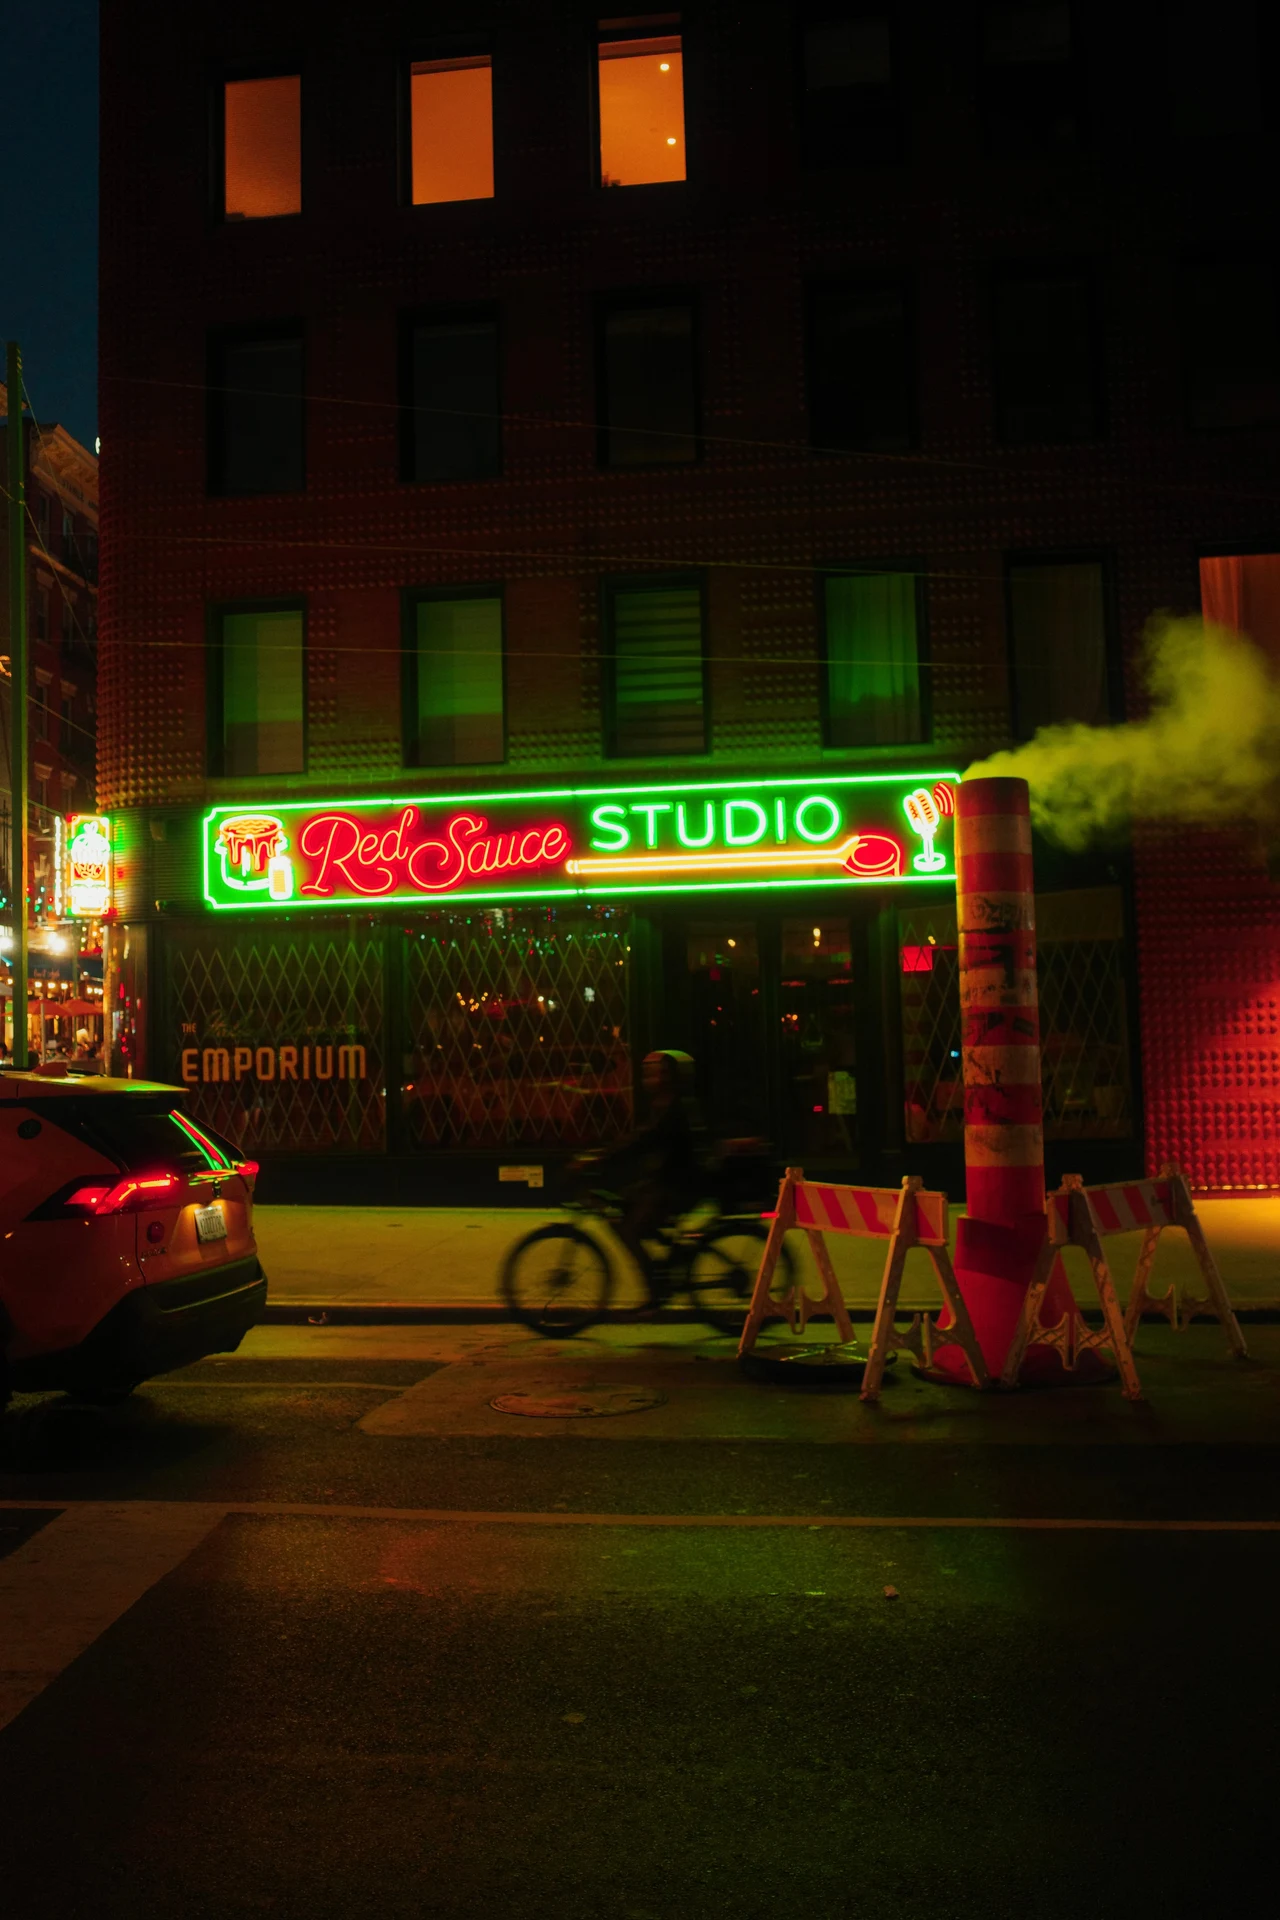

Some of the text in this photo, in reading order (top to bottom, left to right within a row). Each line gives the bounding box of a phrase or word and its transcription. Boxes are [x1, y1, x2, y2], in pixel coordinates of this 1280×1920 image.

[300, 794, 842, 894] Red Sauce STUDIO
[181, 1023, 197, 1034] THE
[181, 1044, 368, 1083] EMPORIUM
